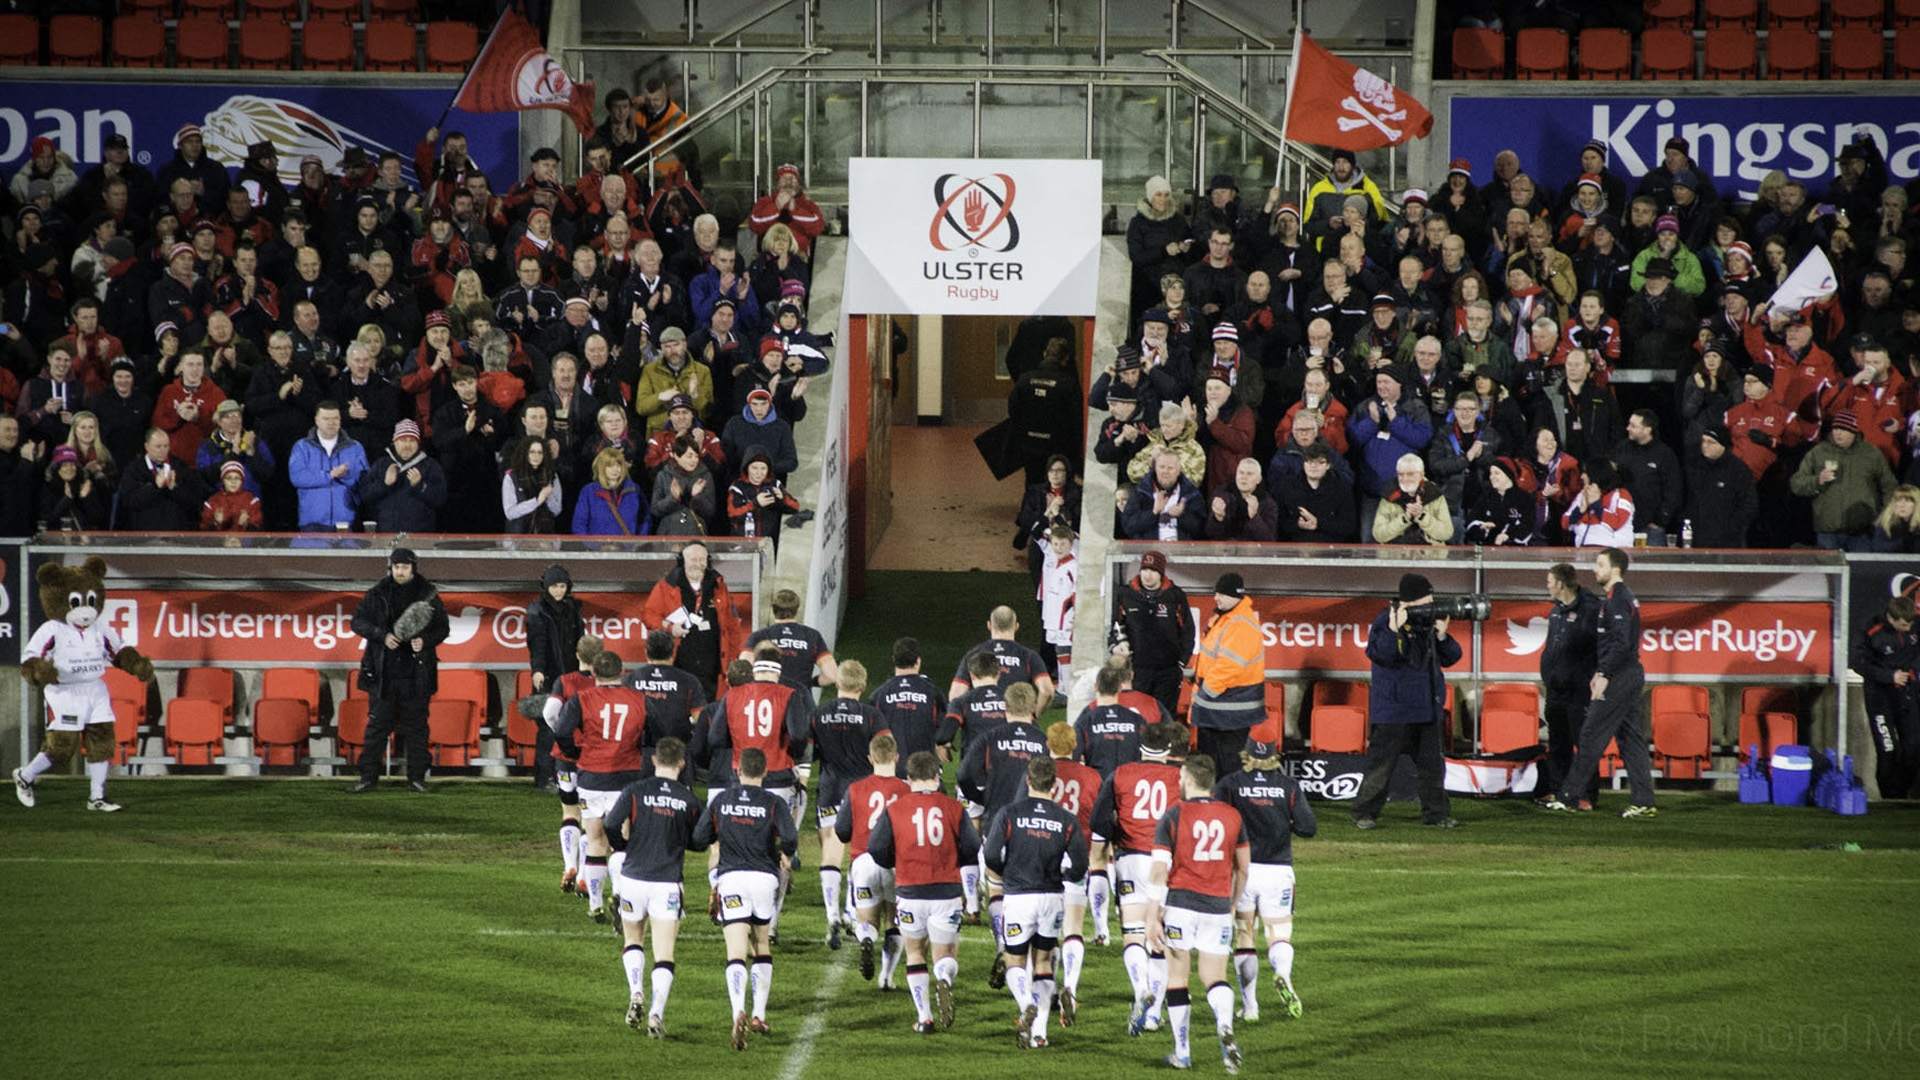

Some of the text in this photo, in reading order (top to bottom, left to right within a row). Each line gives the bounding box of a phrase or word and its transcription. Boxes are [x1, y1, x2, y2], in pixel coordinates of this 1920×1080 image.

[923, 261, 1024, 281] ULSTER
[947, 285, 999, 301] Rugby
[153, 601, 367, 650] /ulsterrugb
[1261, 619, 1372, 648] sterru
[1642, 619, 1817, 662] sterRugby
[995, 655, 1020, 667] TER
[635, 680, 678, 692] ULSTER
[885, 691, 928, 704] ULSTER
[970, 700, 1007, 712] ULSTE
[600, 703, 629, 742] 17
[744, 698, 773, 738] 19
[821, 713, 864, 725] ULSTER
[1092, 721, 1136, 734] ULSTER
[997, 739, 1043, 754] ULSTER
[1238, 786, 1285, 799] ULSTER
[1299, 779, 1355, 796] RO 12
[643, 795, 688, 812] ULSTER
[1132, 778, 1168, 821] 20
[721, 804, 767, 818] ULSTER
[911, 805, 945, 847] 16
[1016, 817, 1063, 833] ULSTER
[1192, 818, 1226, 862] 22
